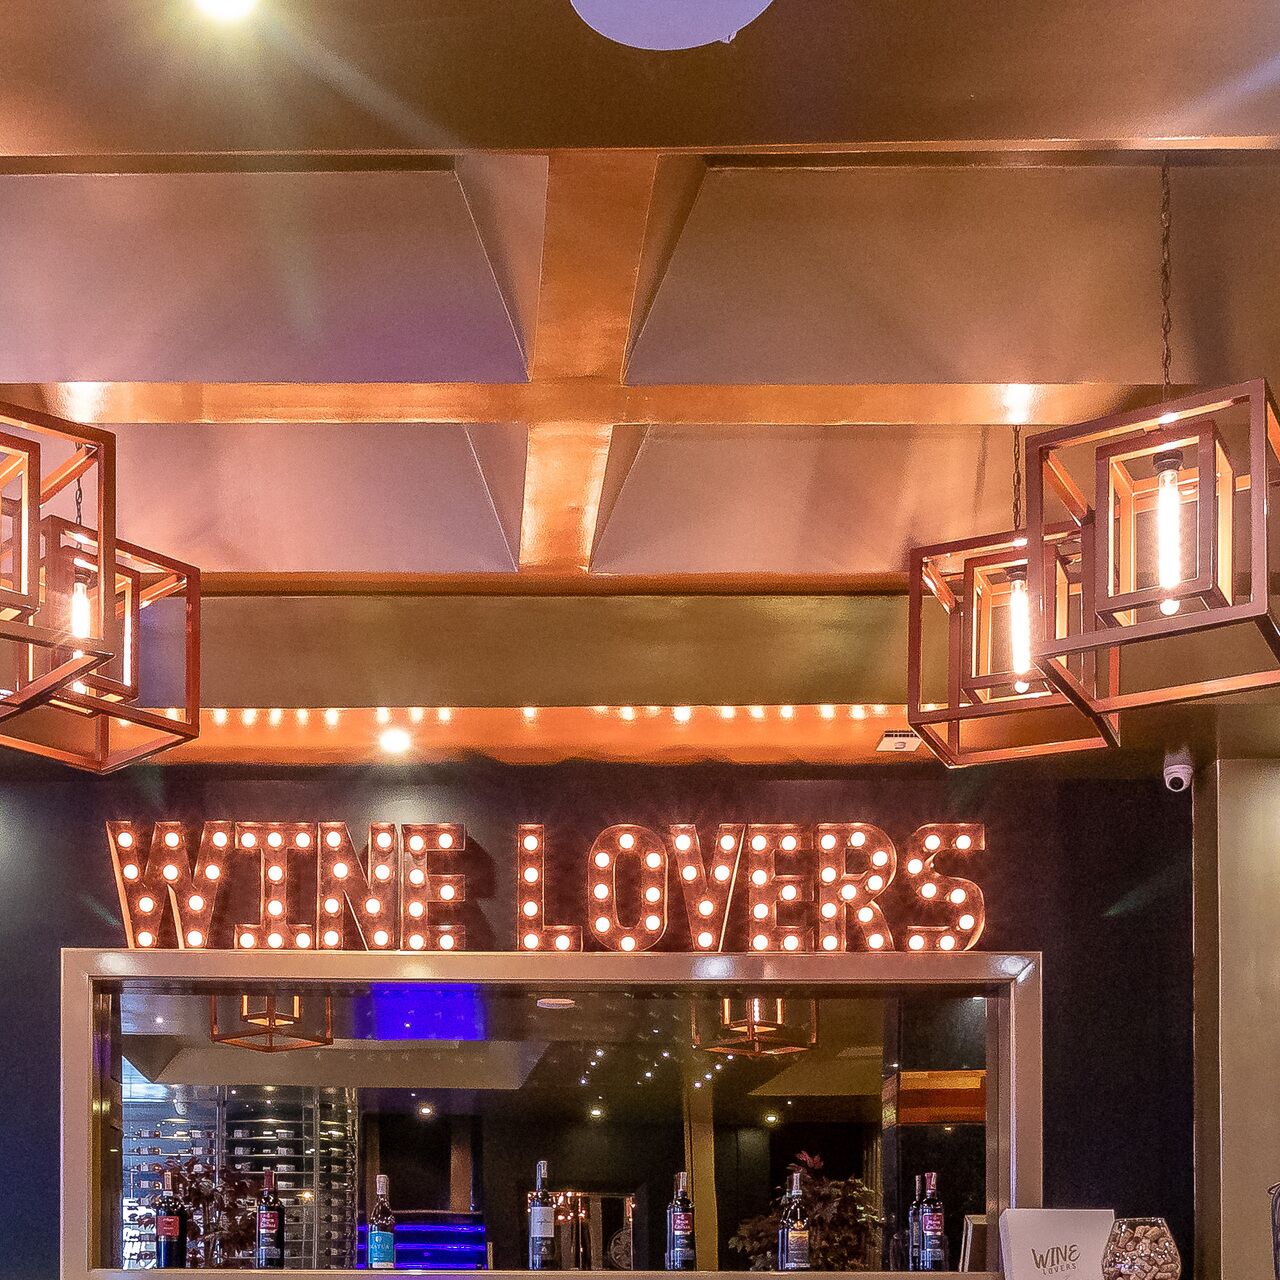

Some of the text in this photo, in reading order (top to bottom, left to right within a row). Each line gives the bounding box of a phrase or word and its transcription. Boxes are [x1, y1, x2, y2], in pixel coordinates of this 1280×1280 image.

[106, 821, 985, 952] WINE LOVERS
[1031, 1244, 1081, 1269] WINE
[1042, 1262, 1077, 1276] LOVERS
